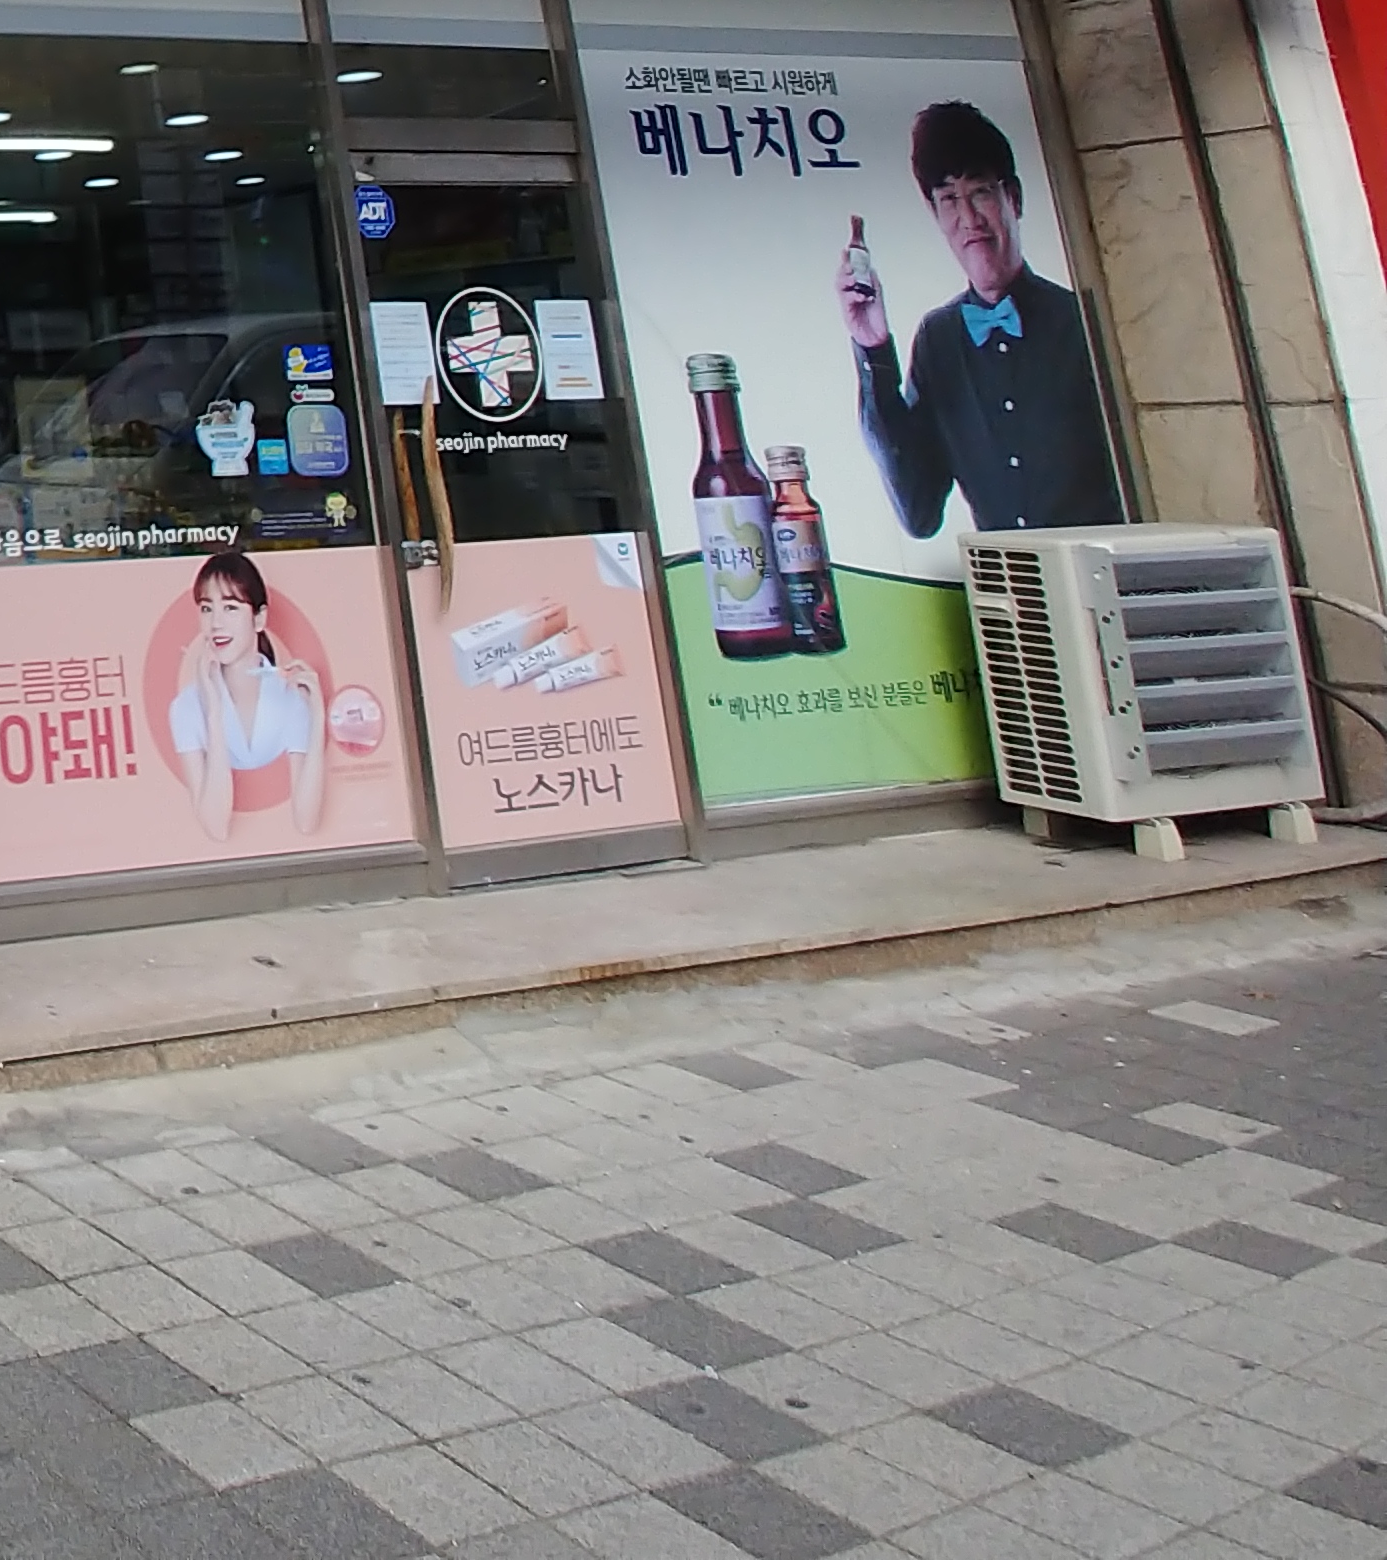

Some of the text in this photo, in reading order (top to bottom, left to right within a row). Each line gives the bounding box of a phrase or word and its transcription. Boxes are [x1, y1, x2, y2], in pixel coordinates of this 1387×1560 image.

[625, 66, 839, 97] 소화안될땐 빠르고 시원하게
[630, 102, 861, 178] 베나치오
[359, 202, 387, 221] ADT
[436, 431, 568, 454] seojin pharmacy
[73, 526, 135, 554] seojin
[138, 522, 239, 549] pharmacy
[728, 694, 793, 721] 베나치오
[796, 688, 845, 713] 효과를
[847, 686, 879, 710] 보신
[882, 680, 928, 705] 분들은
[458, 716, 645, 767] 여드름흉터에도
[493, 763, 624, 814] 노스카나
